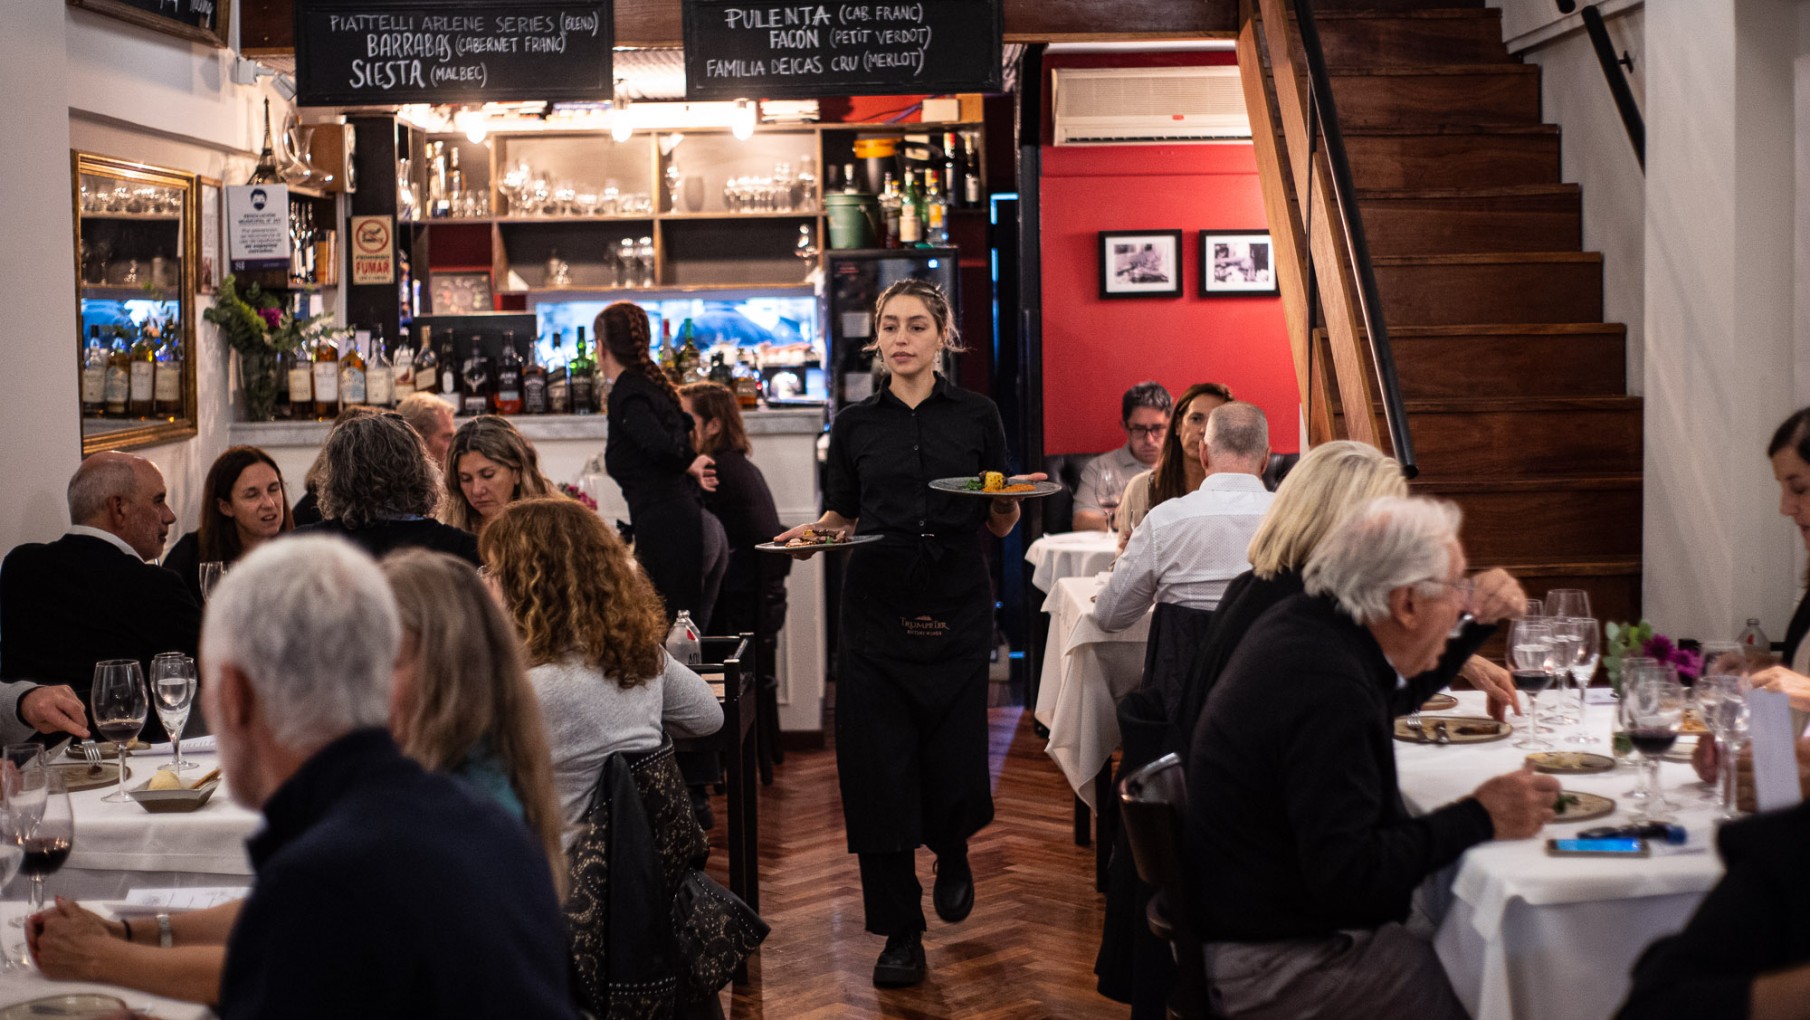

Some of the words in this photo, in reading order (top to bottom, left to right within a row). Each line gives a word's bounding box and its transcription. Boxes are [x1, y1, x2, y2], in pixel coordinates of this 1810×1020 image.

[330, 14, 414, 32] PIATTELLI
[421, 15, 485, 32] ARLENE
[495, 16, 555, 33] SERIES
[560, 11, 599, 37] (BLEND)
[724, 5, 831, 28] PULENTA
[875, 3, 924, 24] FRANC)
[367, 33, 451, 62] BARRABAS
[455, 34, 519, 57] (CABERNET
[525, 31, 567, 54] FRANC)
[769, 25, 820, 49] FACÓN
[876, 25, 932, 50] VERDOT)
[349, 59, 426, 89] SIESTA
[430, 62, 488, 88] (MALBEC)
[706, 58, 766, 78] FAMILIA
[771, 55, 824, 75] DEICAS
[831, 55, 858, 71] CRU
[863, 47, 925, 76] (MERLOT)
[356, 261, 390, 274] FUMAR
